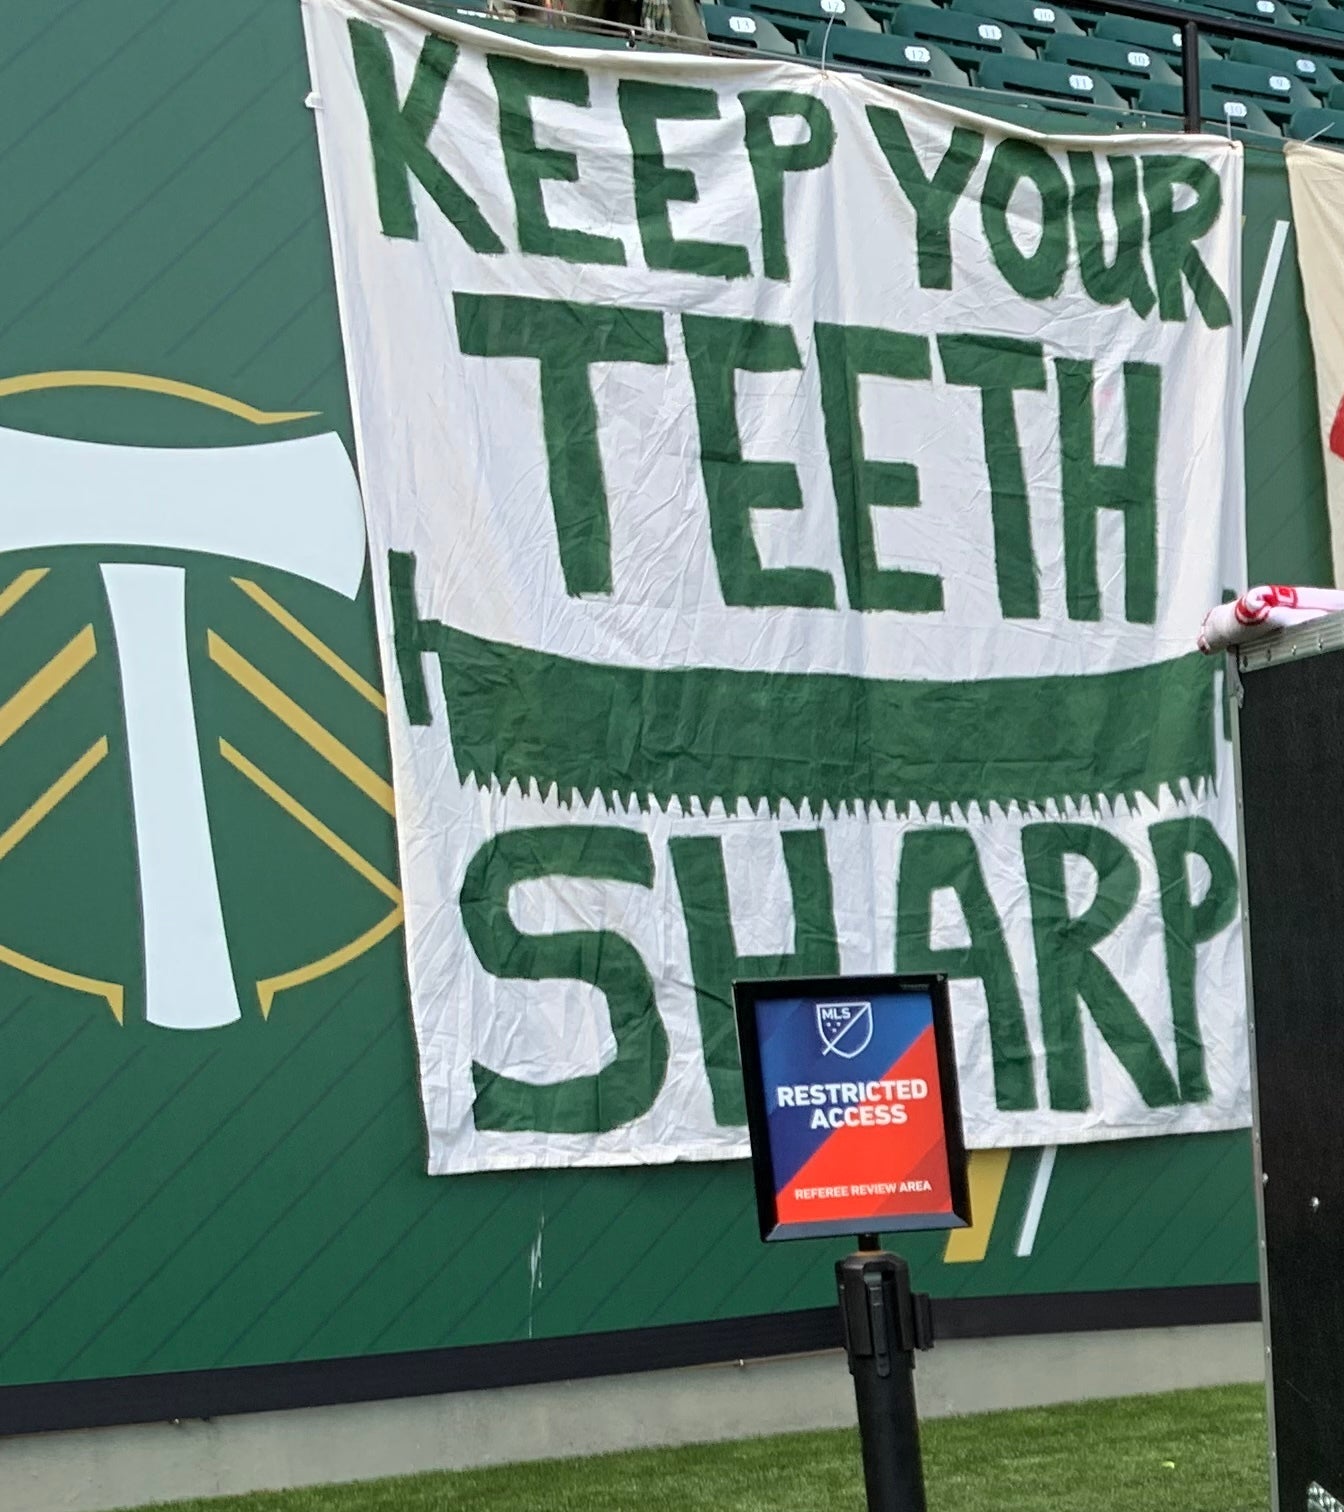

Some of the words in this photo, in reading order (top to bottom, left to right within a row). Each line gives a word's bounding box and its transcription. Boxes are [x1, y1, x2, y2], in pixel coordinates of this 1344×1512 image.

[347, 19, 837, 283] KEEP
[866, 105, 1231, 329] YOUR
[454, 291, 1161, 625] TEETH
[460, 815, 1239, 1135] SHARP
[822, 1007, 851, 1020] MLS
[777, 1078, 928, 1108] RESTRICTED
[810, 1104, 908, 1130] ACCESS
[794, 1184, 849, 1200] REFEREE
[850, 1182, 896, 1197] REVIEW
[899, 1180, 932, 1193] AREA
